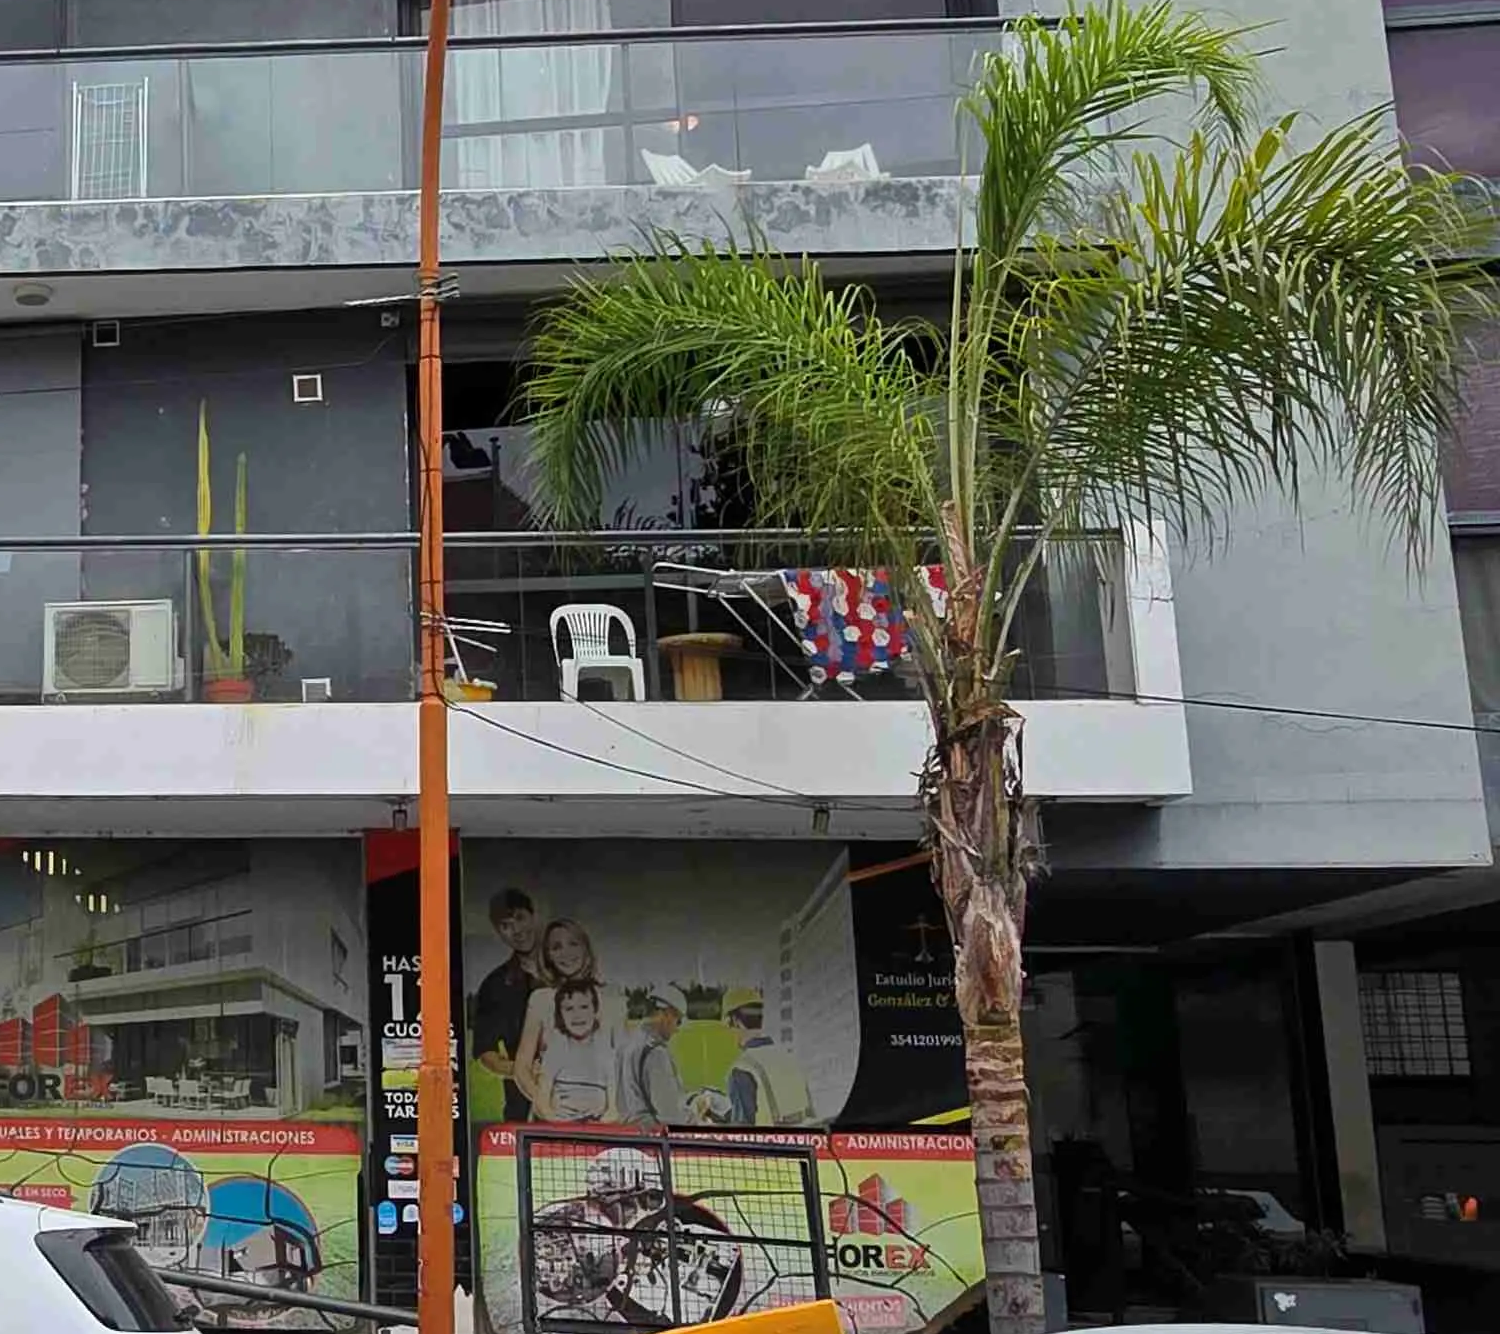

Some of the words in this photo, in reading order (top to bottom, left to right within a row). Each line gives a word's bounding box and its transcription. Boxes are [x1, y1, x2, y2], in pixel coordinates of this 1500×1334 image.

[382, 954, 422, 973] HAS
[875, 972, 925, 986] Estudio
[43, 1126, 53, 1140] Y
[57, 1127, 157, 1142] TEMPORARIOS
[171, 1128, 316, 1146] ADMINISTRACIONES
